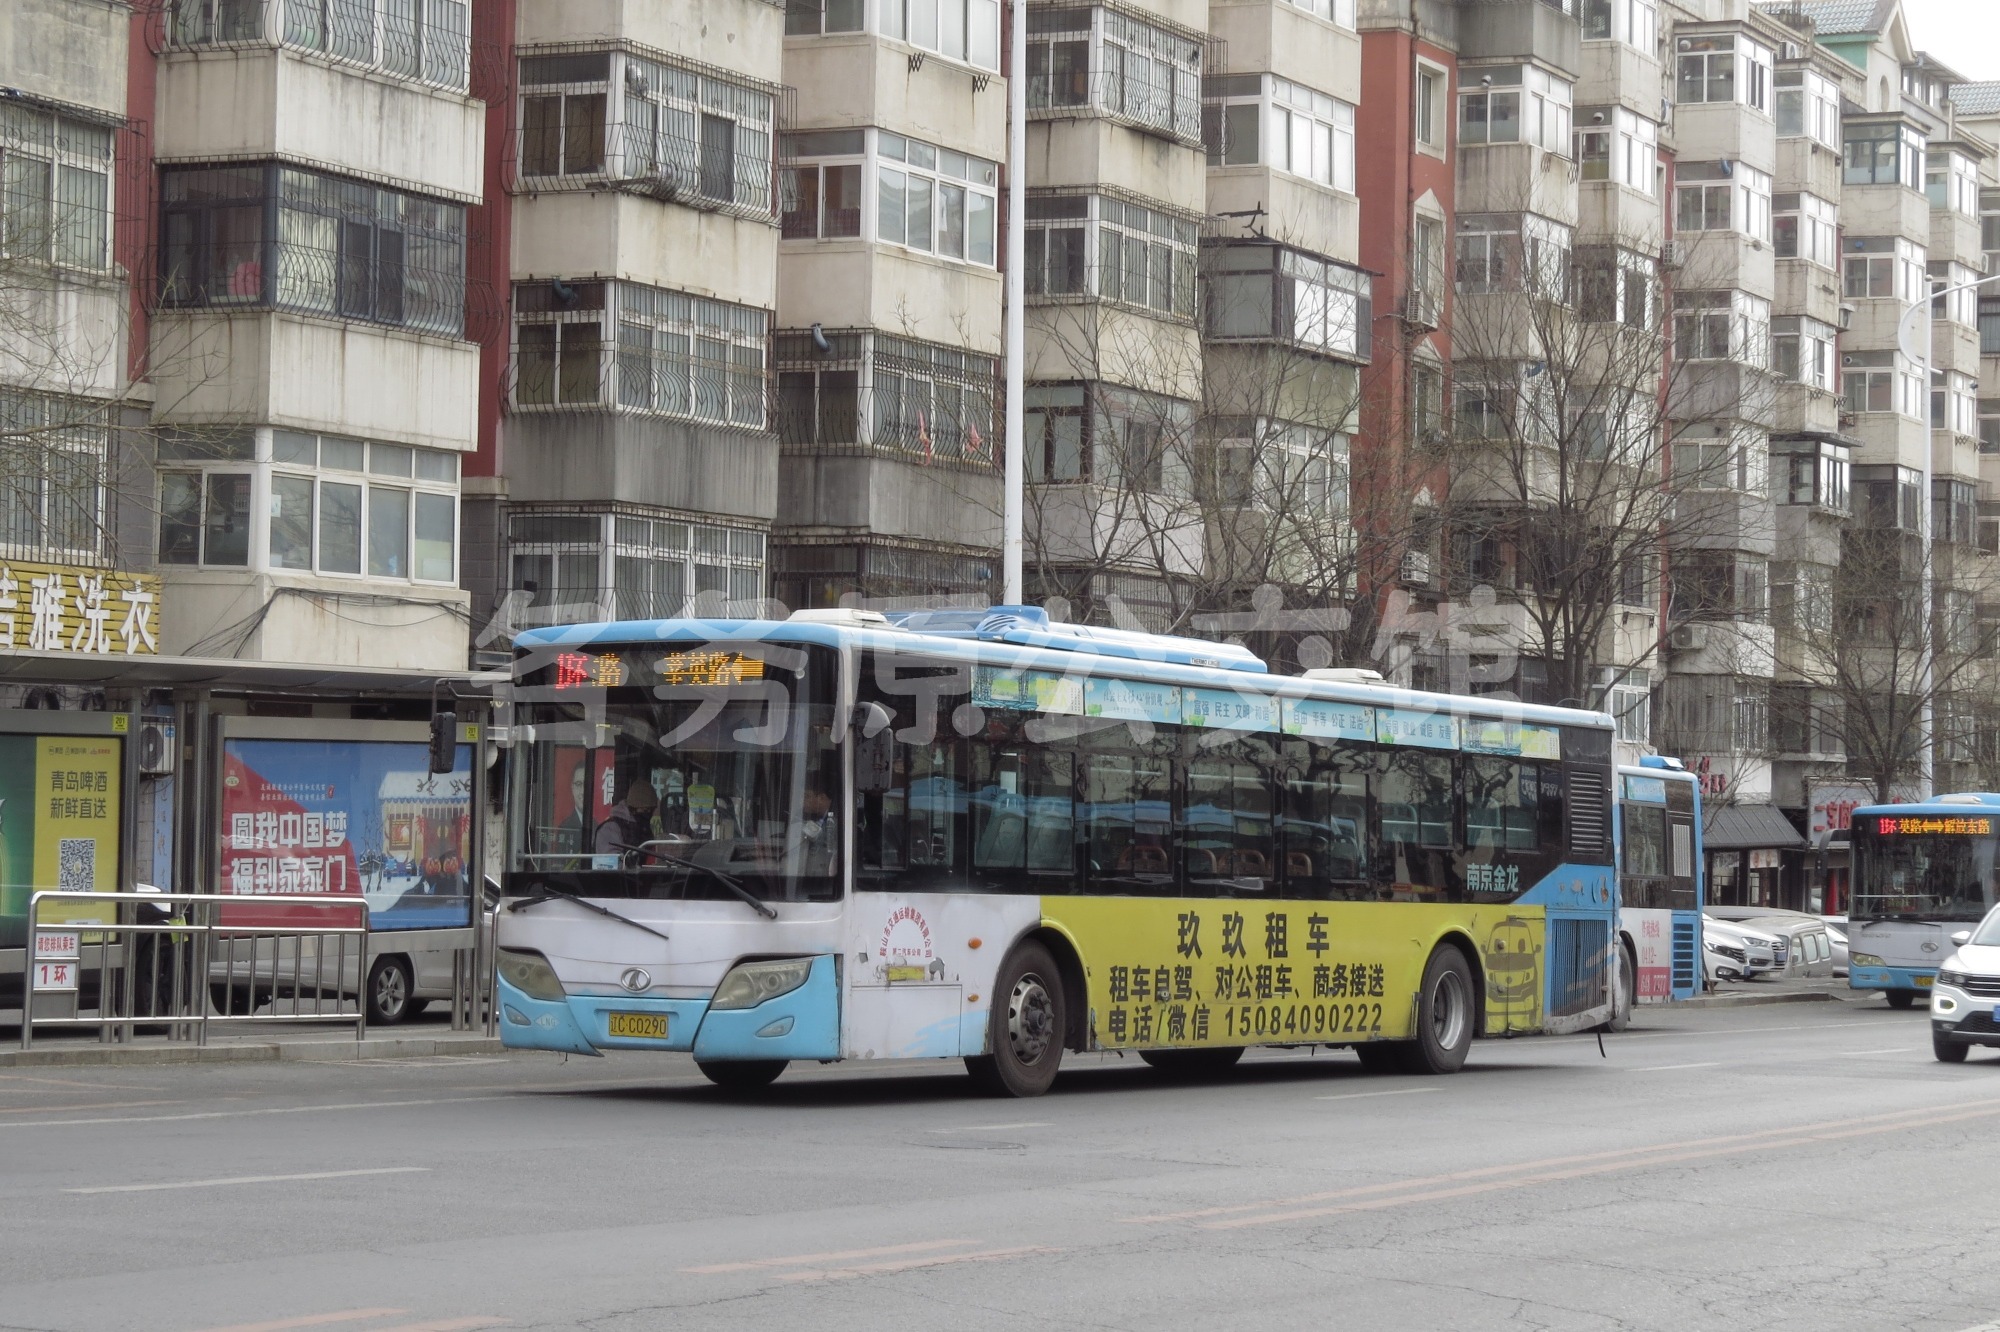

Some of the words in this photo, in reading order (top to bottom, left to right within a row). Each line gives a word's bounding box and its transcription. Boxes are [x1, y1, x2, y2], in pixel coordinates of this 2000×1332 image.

[1215, 701, 1230, 718] 民主
[1294, 710, 1308, 725] 自由
[1313, 711, 1327, 727] 平等
[1332, 713, 1346, 729] 公正
[51, 770, 108, 792] 青岛啤酒
[50, 797, 107, 819] 新鲜直送
[232, 811, 347, 849] 圆我中国梦
[231, 854, 347, 895] 福到家家门
[1466, 862, 1519, 892] 南京金龙
[38, 936, 75, 952] 请您排队乘车
[1176, 910, 1330, 960] 玖玖租车
[1108, 1004, 1211, 1043] 电话/微信
[1225, 1002, 1383, 1038] 15084090222
